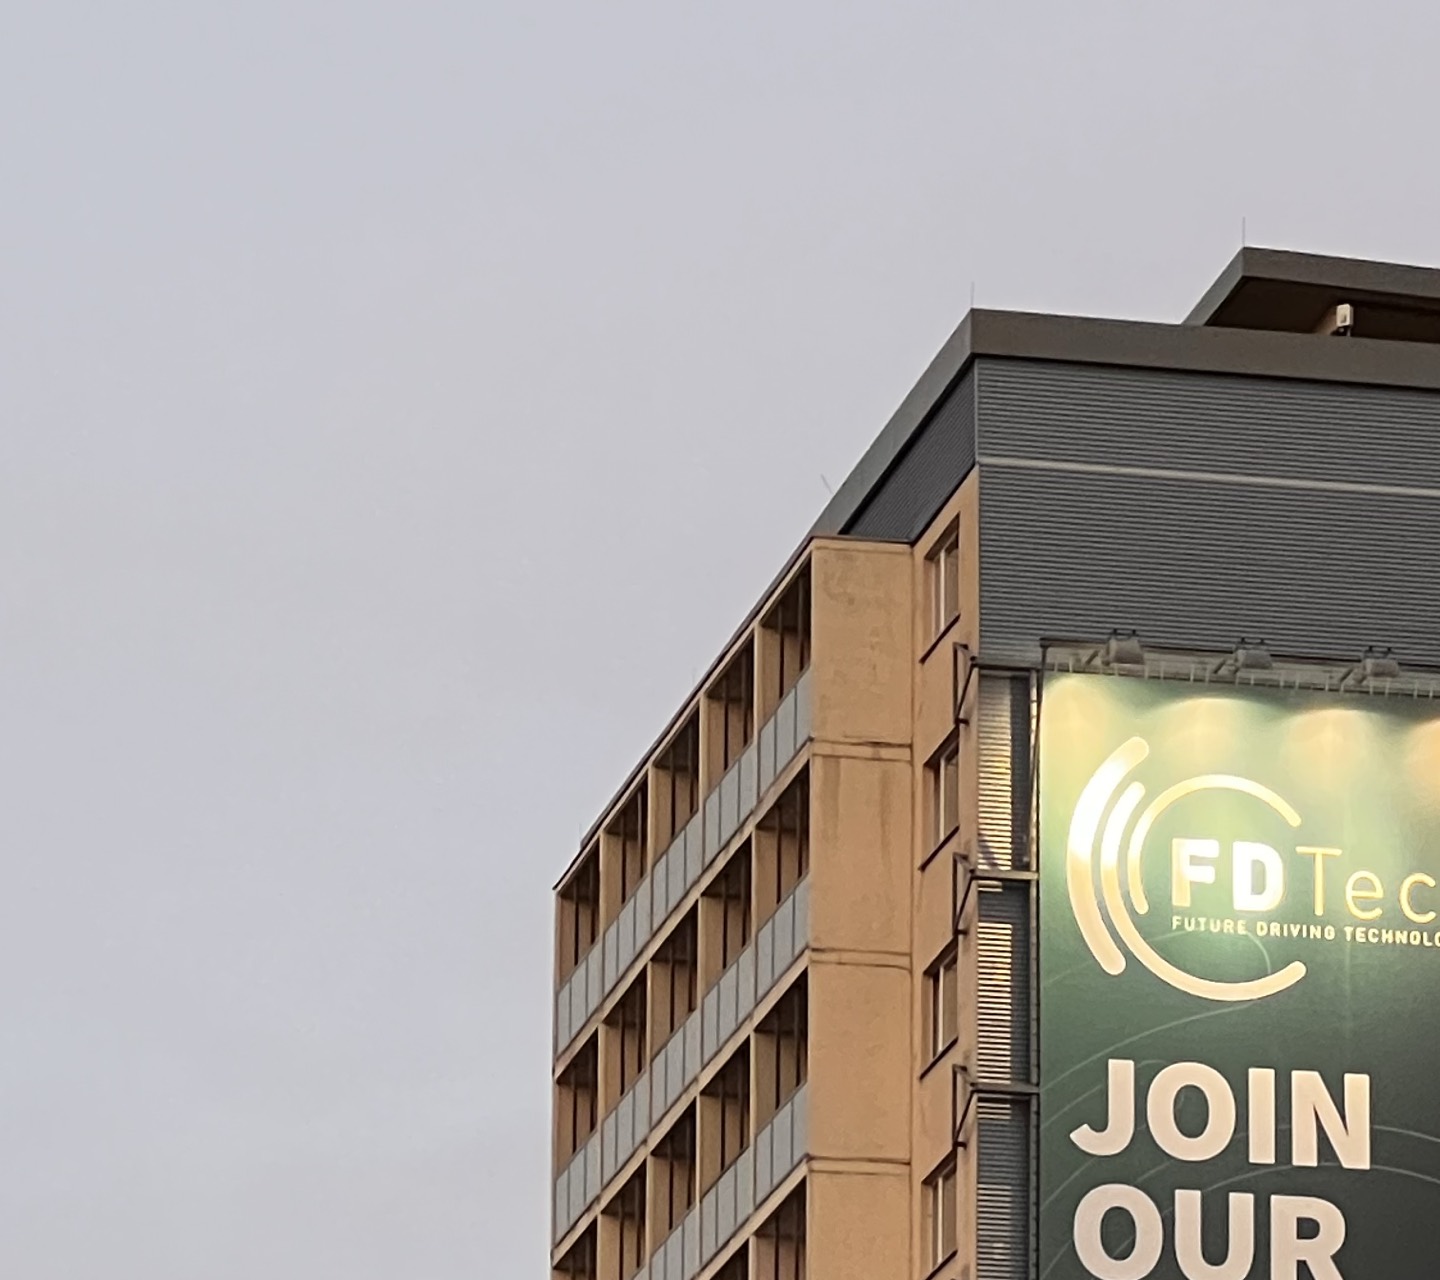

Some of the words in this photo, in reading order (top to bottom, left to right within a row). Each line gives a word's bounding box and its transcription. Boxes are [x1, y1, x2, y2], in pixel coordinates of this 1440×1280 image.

[1171, 915, 1248, 935] FUTURE
[1256, 921, 1336, 940] DRIVING
[1069, 1058, 1371, 1170] JOIN
